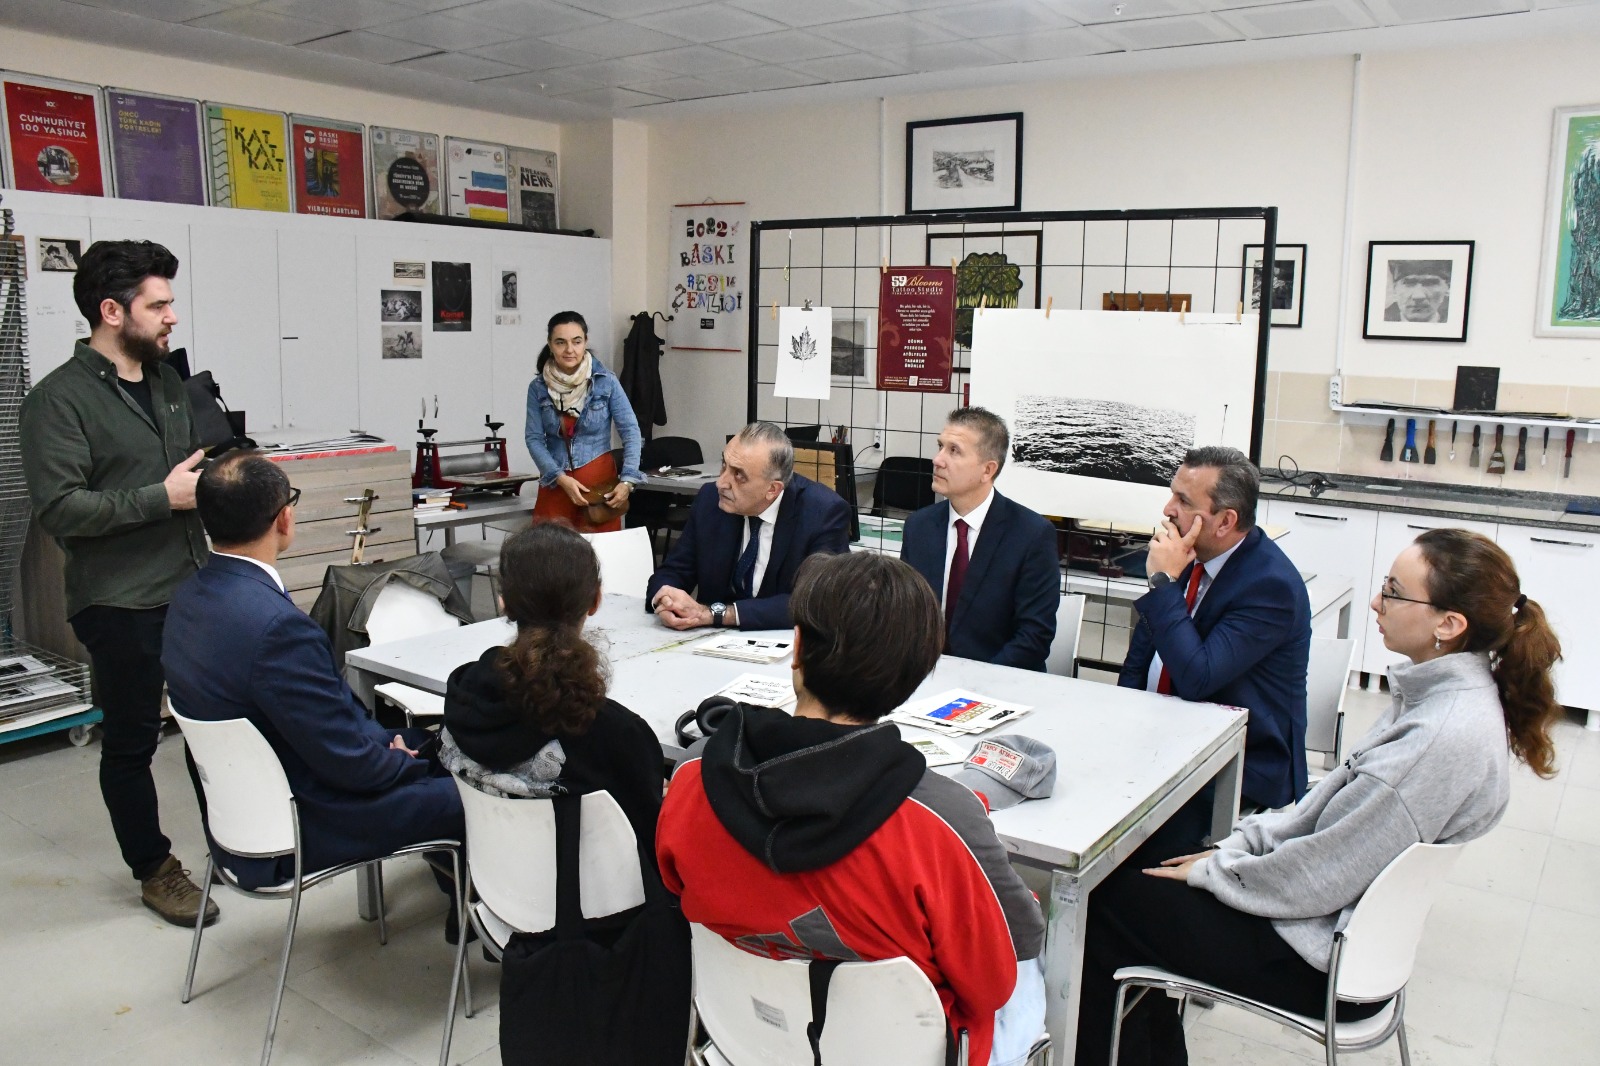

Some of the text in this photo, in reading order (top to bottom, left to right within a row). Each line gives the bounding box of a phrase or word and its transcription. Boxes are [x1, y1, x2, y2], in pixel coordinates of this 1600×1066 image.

[19, 114, 86, 130] CUMHURİYET
[139, 119, 161, 127] KADIN
[20, 123, 40, 133] 100
[43, 126, 88, 139] YAŞINDA
[234, 126, 271, 147] KAT
[241, 140, 277, 162] KAT
[248, 154, 284, 172] KAT
[520, 174, 553, 188] NEWS
[680, 243, 735, 267] BASKI
[907, 274, 943, 287] Blooms
